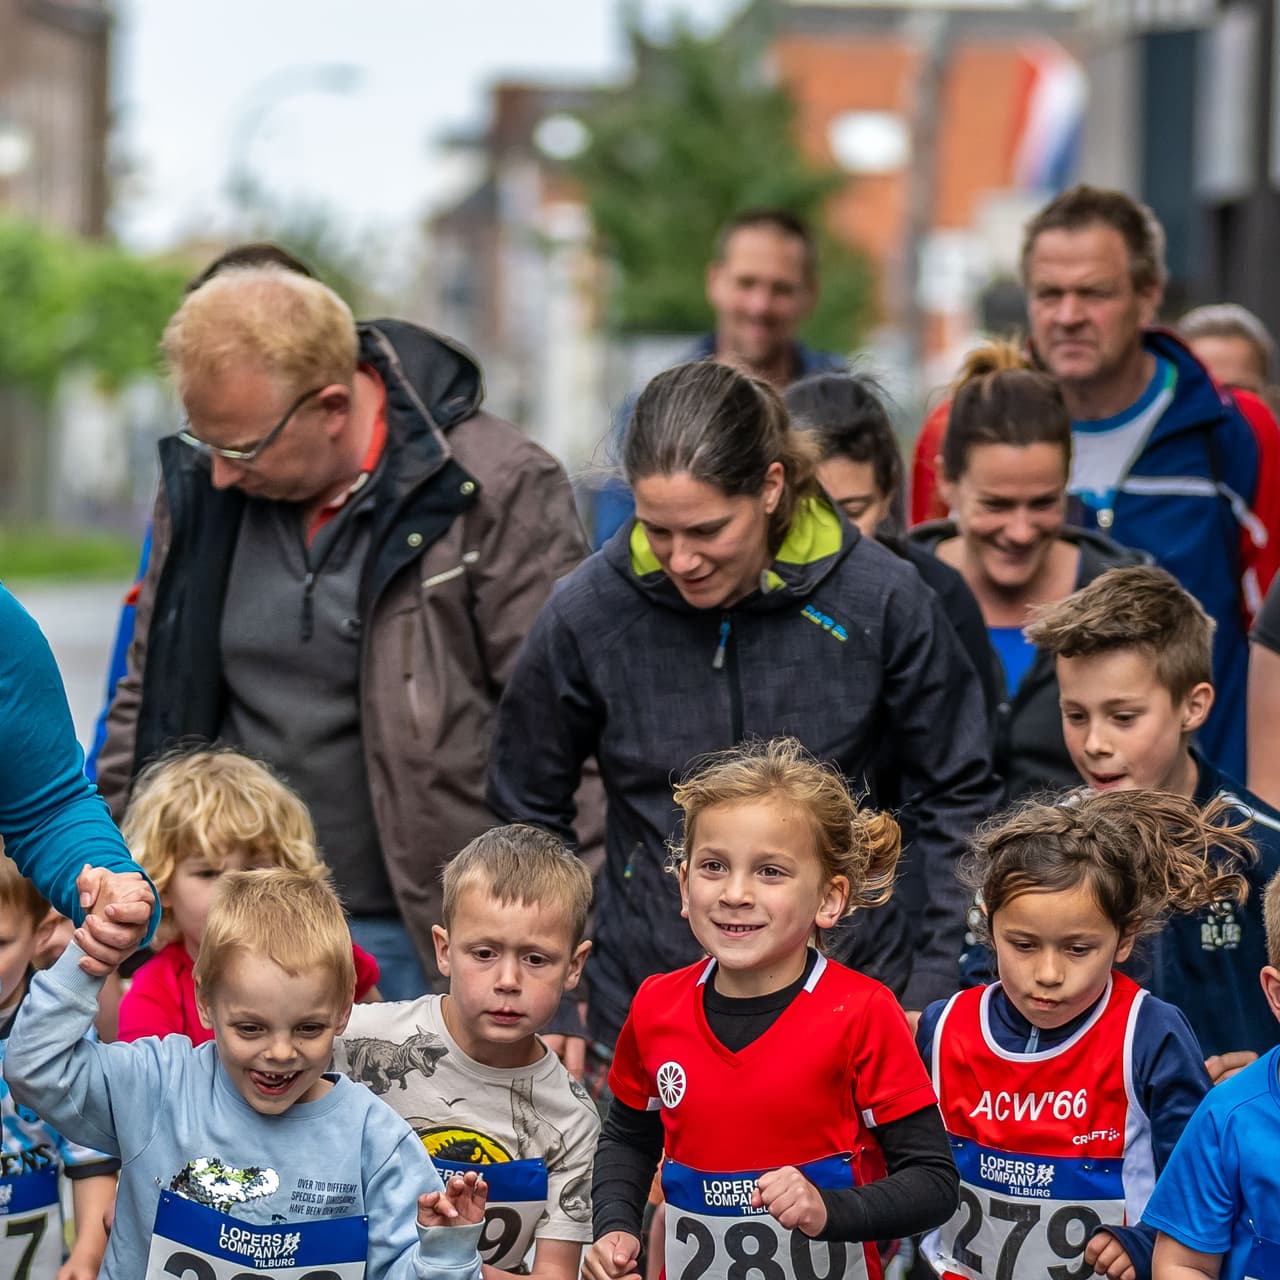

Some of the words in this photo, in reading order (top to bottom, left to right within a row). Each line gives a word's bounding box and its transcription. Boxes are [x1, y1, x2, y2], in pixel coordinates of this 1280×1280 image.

[969, 1088, 1088, 1121] ACW'66
[980, 1153, 1036, 1175] LOPERS
[980, 1166, 1035, 1186] COMPANY
[705, 1192, 752, 1207] COMPA
[1008, 1186, 1051, 1198] TILBURG
[220, 1223, 282, 1246] LOPERS
[219, 1237, 281, 1259] COMPANY
[254, 1258, 296, 1268] TILBURG
